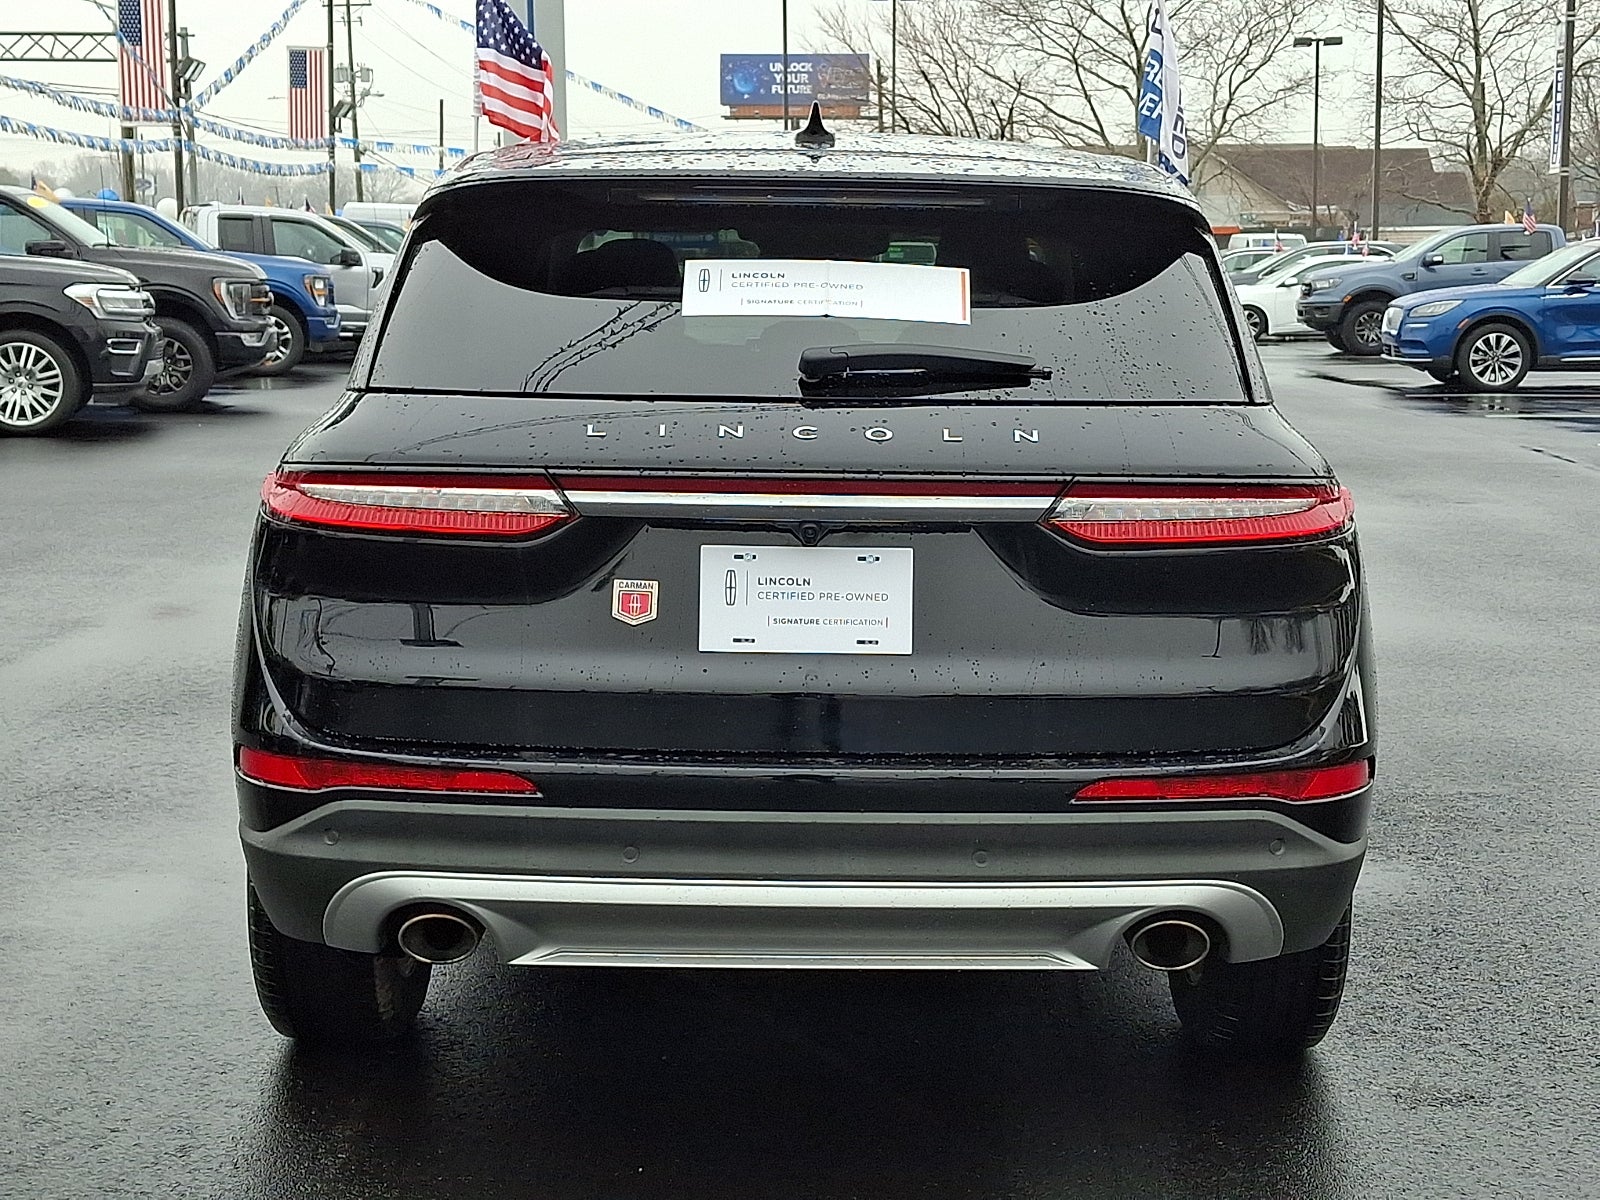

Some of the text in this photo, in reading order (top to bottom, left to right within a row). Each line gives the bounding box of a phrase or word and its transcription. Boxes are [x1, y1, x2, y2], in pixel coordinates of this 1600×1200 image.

[774, 73, 809, 83] YOUR
[771, 85, 812, 94] FUTURE
[793, 281, 864, 290] PRE-OWNED
[586, 423, 1040, 443] LINCOLN
[618, 581, 654, 590] CARMAN
[757, 576, 811, 586] LINCOLN
[757, 591, 889, 602] CERTIFIED PRE-OWNED
[772, 617, 884, 626] SIGNATURE CERTIFICATION
